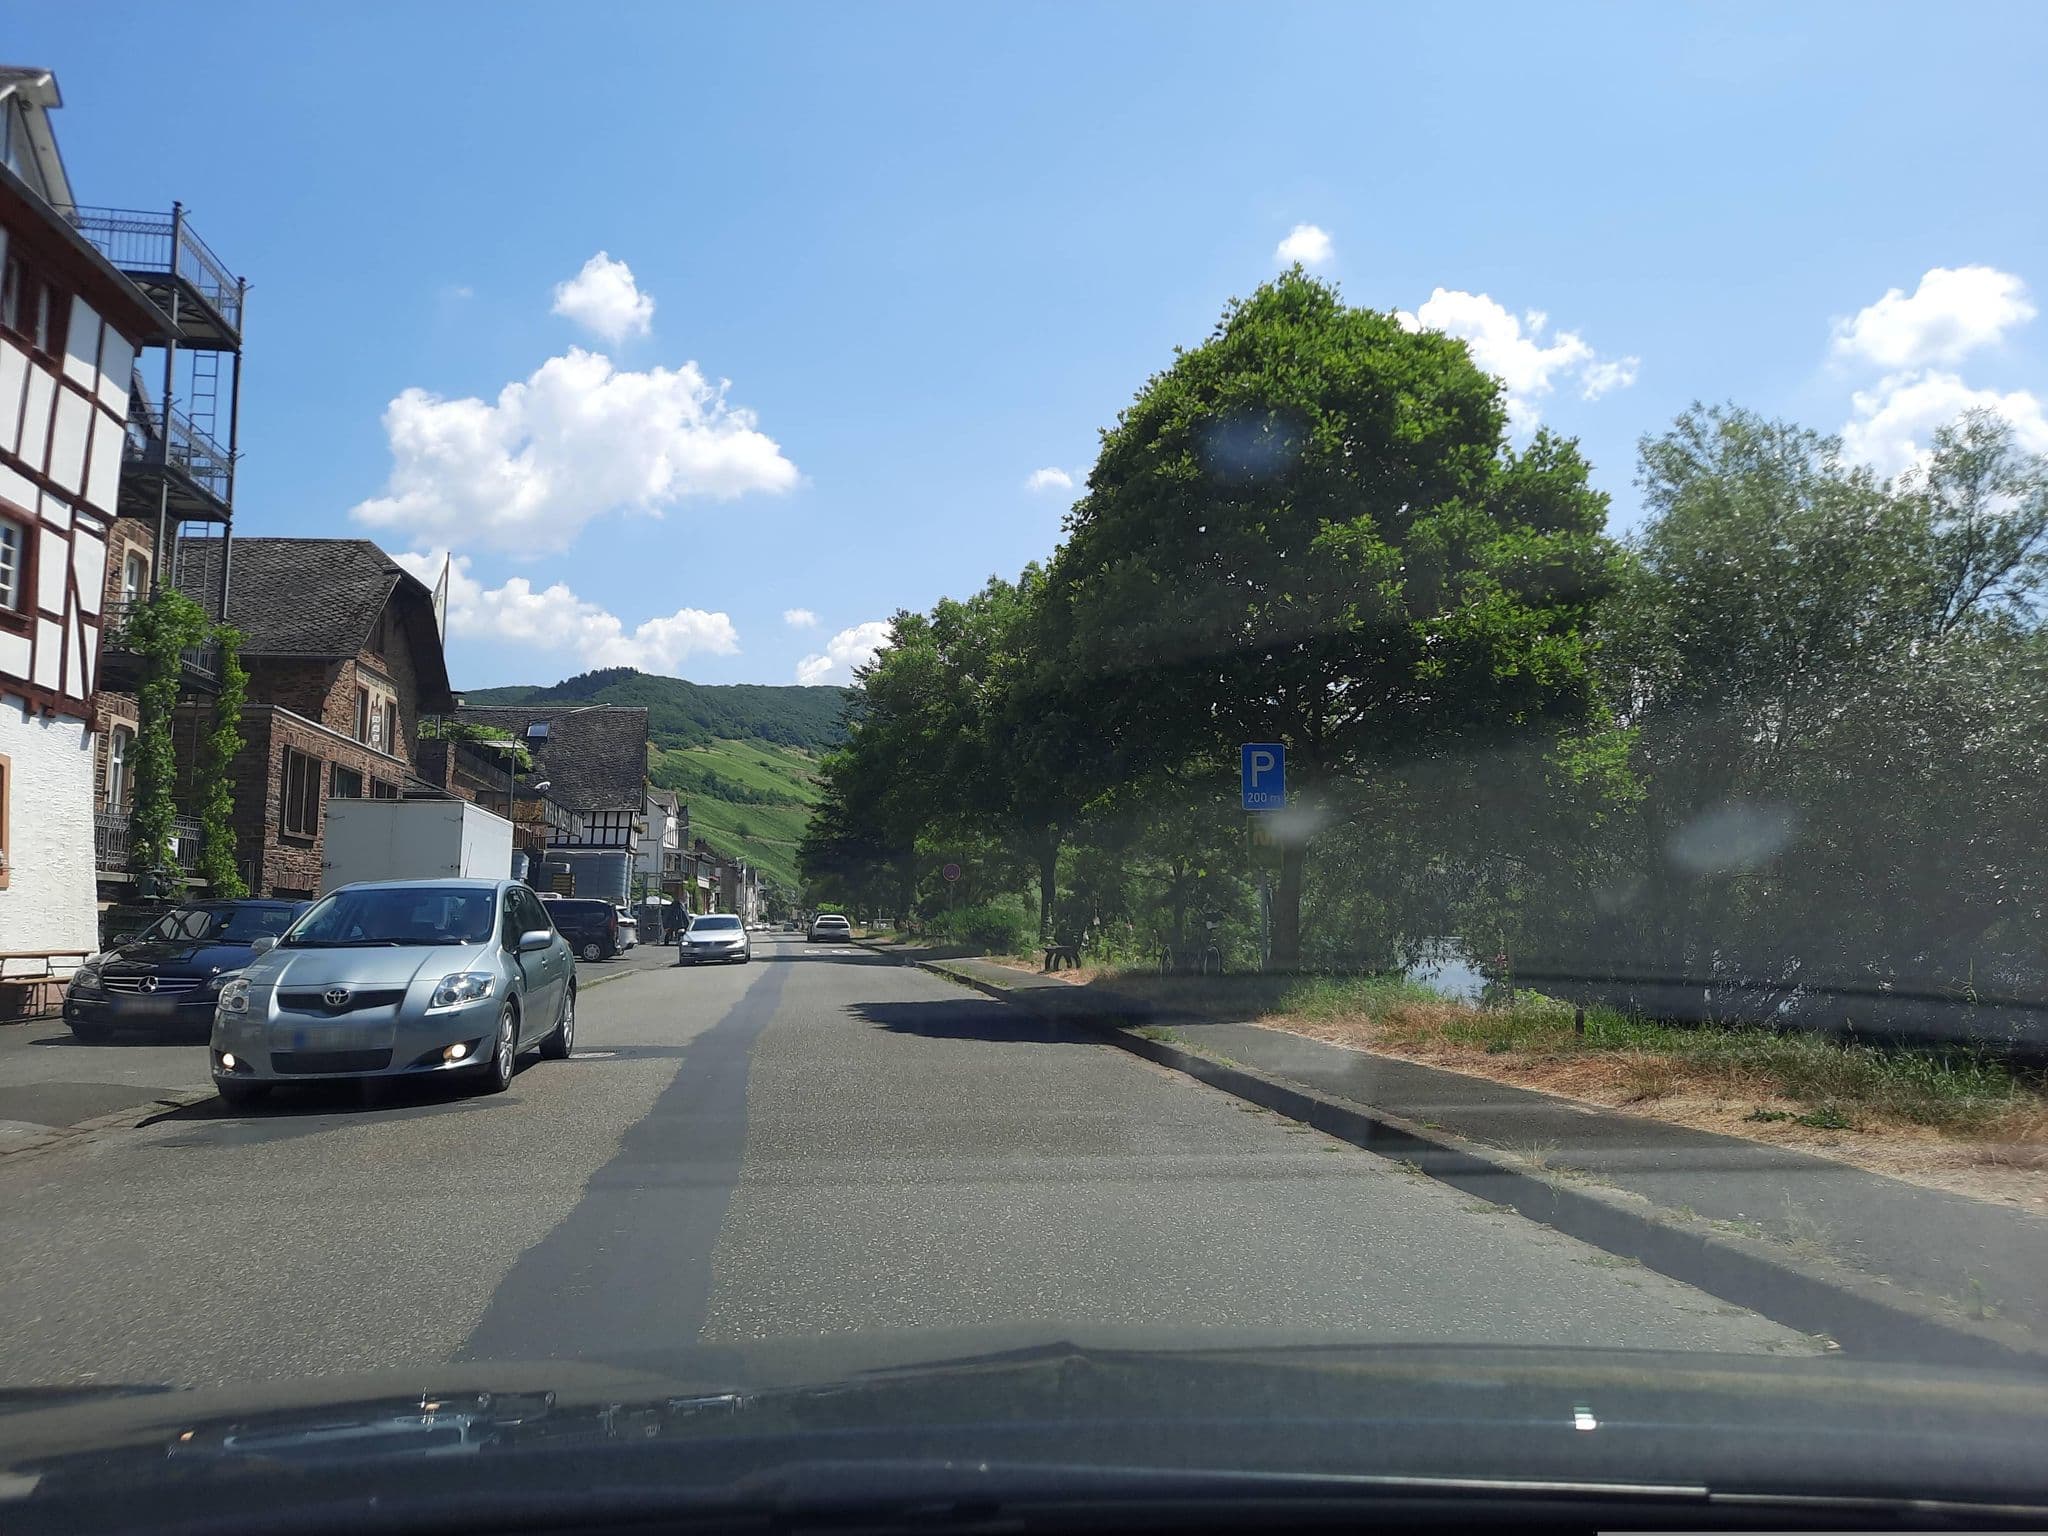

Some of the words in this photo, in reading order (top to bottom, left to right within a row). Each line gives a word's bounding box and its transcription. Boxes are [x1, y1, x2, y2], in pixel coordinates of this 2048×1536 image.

[1251, 751, 1275, 787] P
[1247, 792, 1267, 803] 200
[1270, 795, 1281, 803] m
